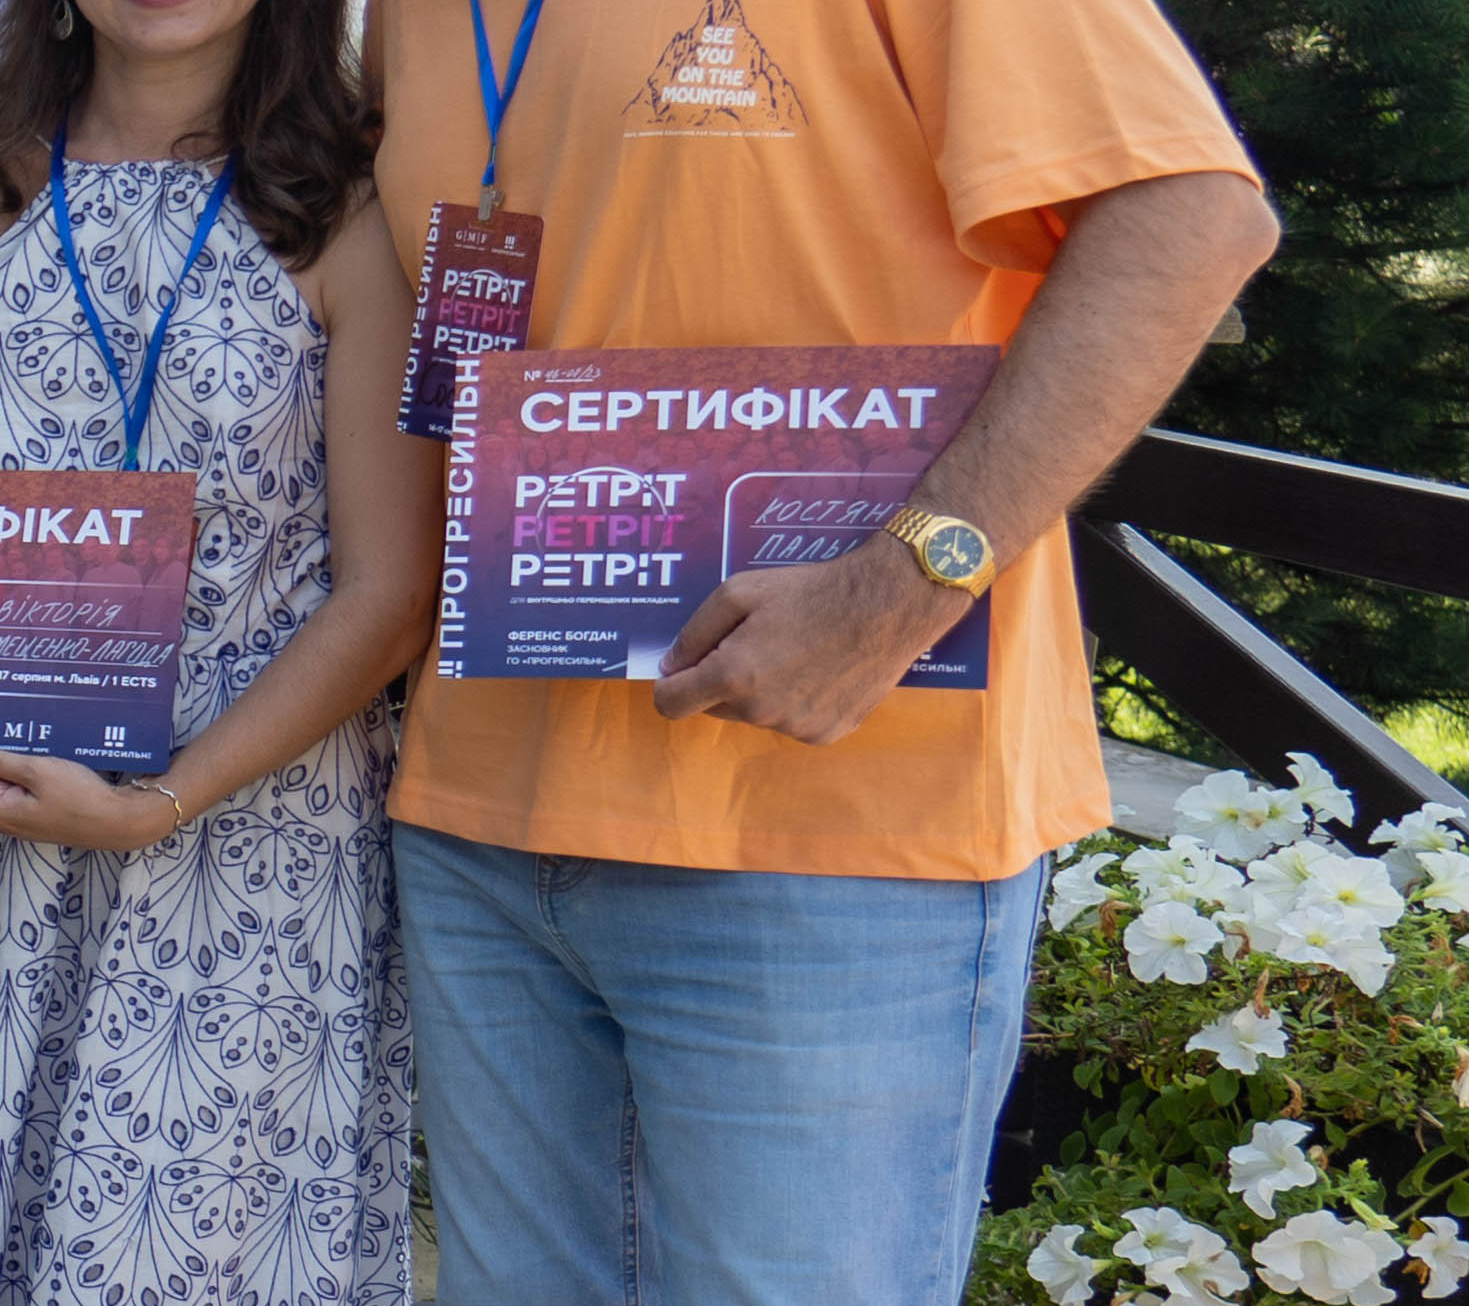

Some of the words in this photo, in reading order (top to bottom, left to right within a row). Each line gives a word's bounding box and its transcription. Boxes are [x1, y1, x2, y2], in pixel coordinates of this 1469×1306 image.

[701, 25, 736, 44] SEE
[696, 46, 734, 65] YOU
[678, 66, 704, 83] ON
[708, 68, 744, 86] THE
[661, 86, 756, 106] MOUNTAIN
[520, 387, 937, 433] СЕРТИФІКАТ
[755, 497, 904, 524] КОСТЯН
[507, 631, 561, 641] ФЕРЕНС
[565, 631, 617, 642] БОГДАН
[68, 673, 99, 685] Львів
[121, 677, 157, 688] ECTS
